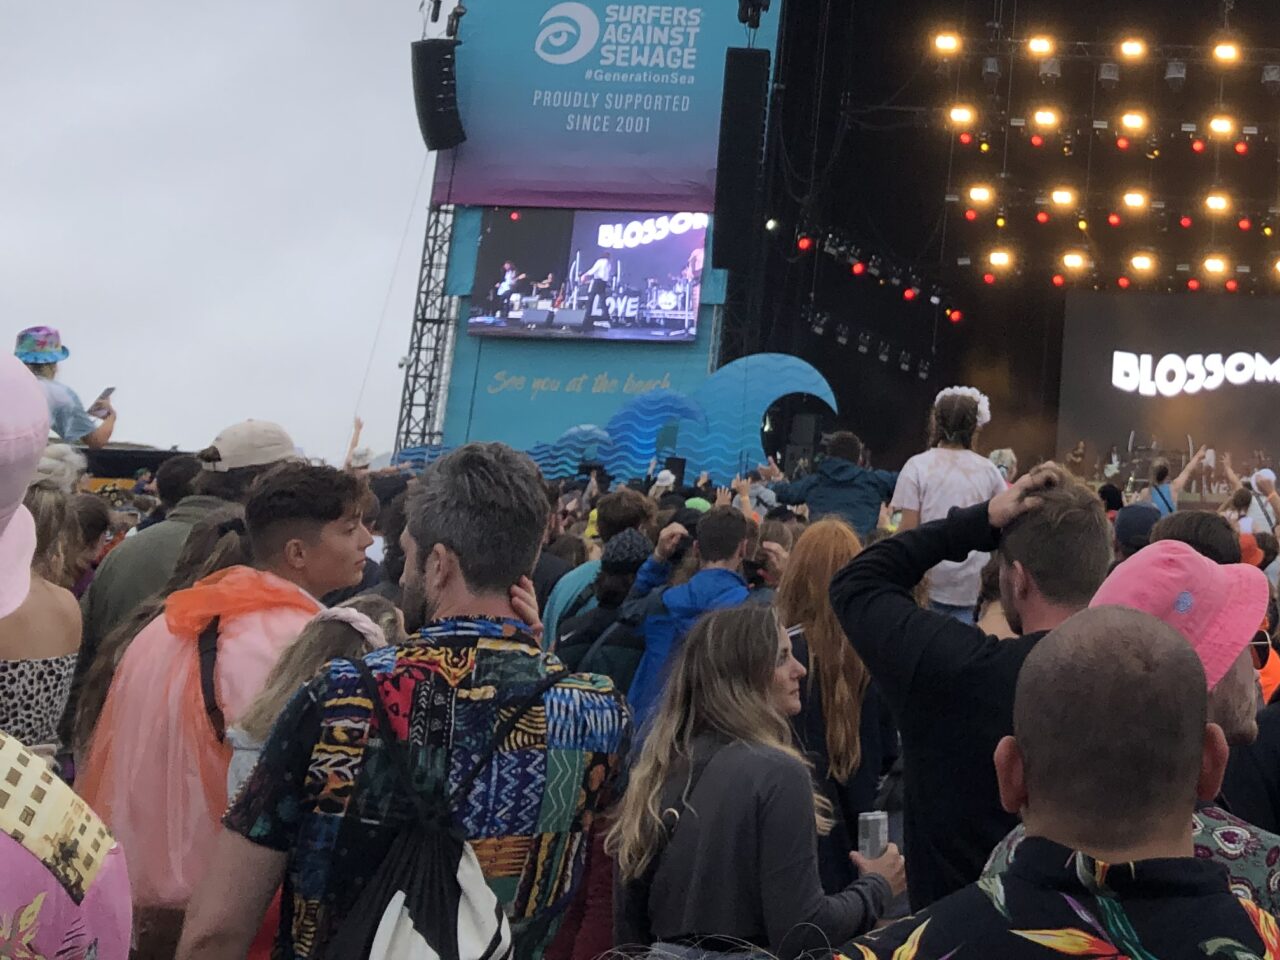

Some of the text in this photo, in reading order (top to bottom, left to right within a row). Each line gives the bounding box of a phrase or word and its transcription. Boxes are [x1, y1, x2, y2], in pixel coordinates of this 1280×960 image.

[605, 4, 700, 26] SURFERS
[602, 24, 699, 47] AGAINST
[600, 45, 697, 69] SEWAGE
[585, 69, 694, 84] #GenerationSea
[533, 90, 690, 111] PROUDLY SUPPORTED
[566, 114, 650, 132] SINCE 2001
[566, 374, 588, 392] at
